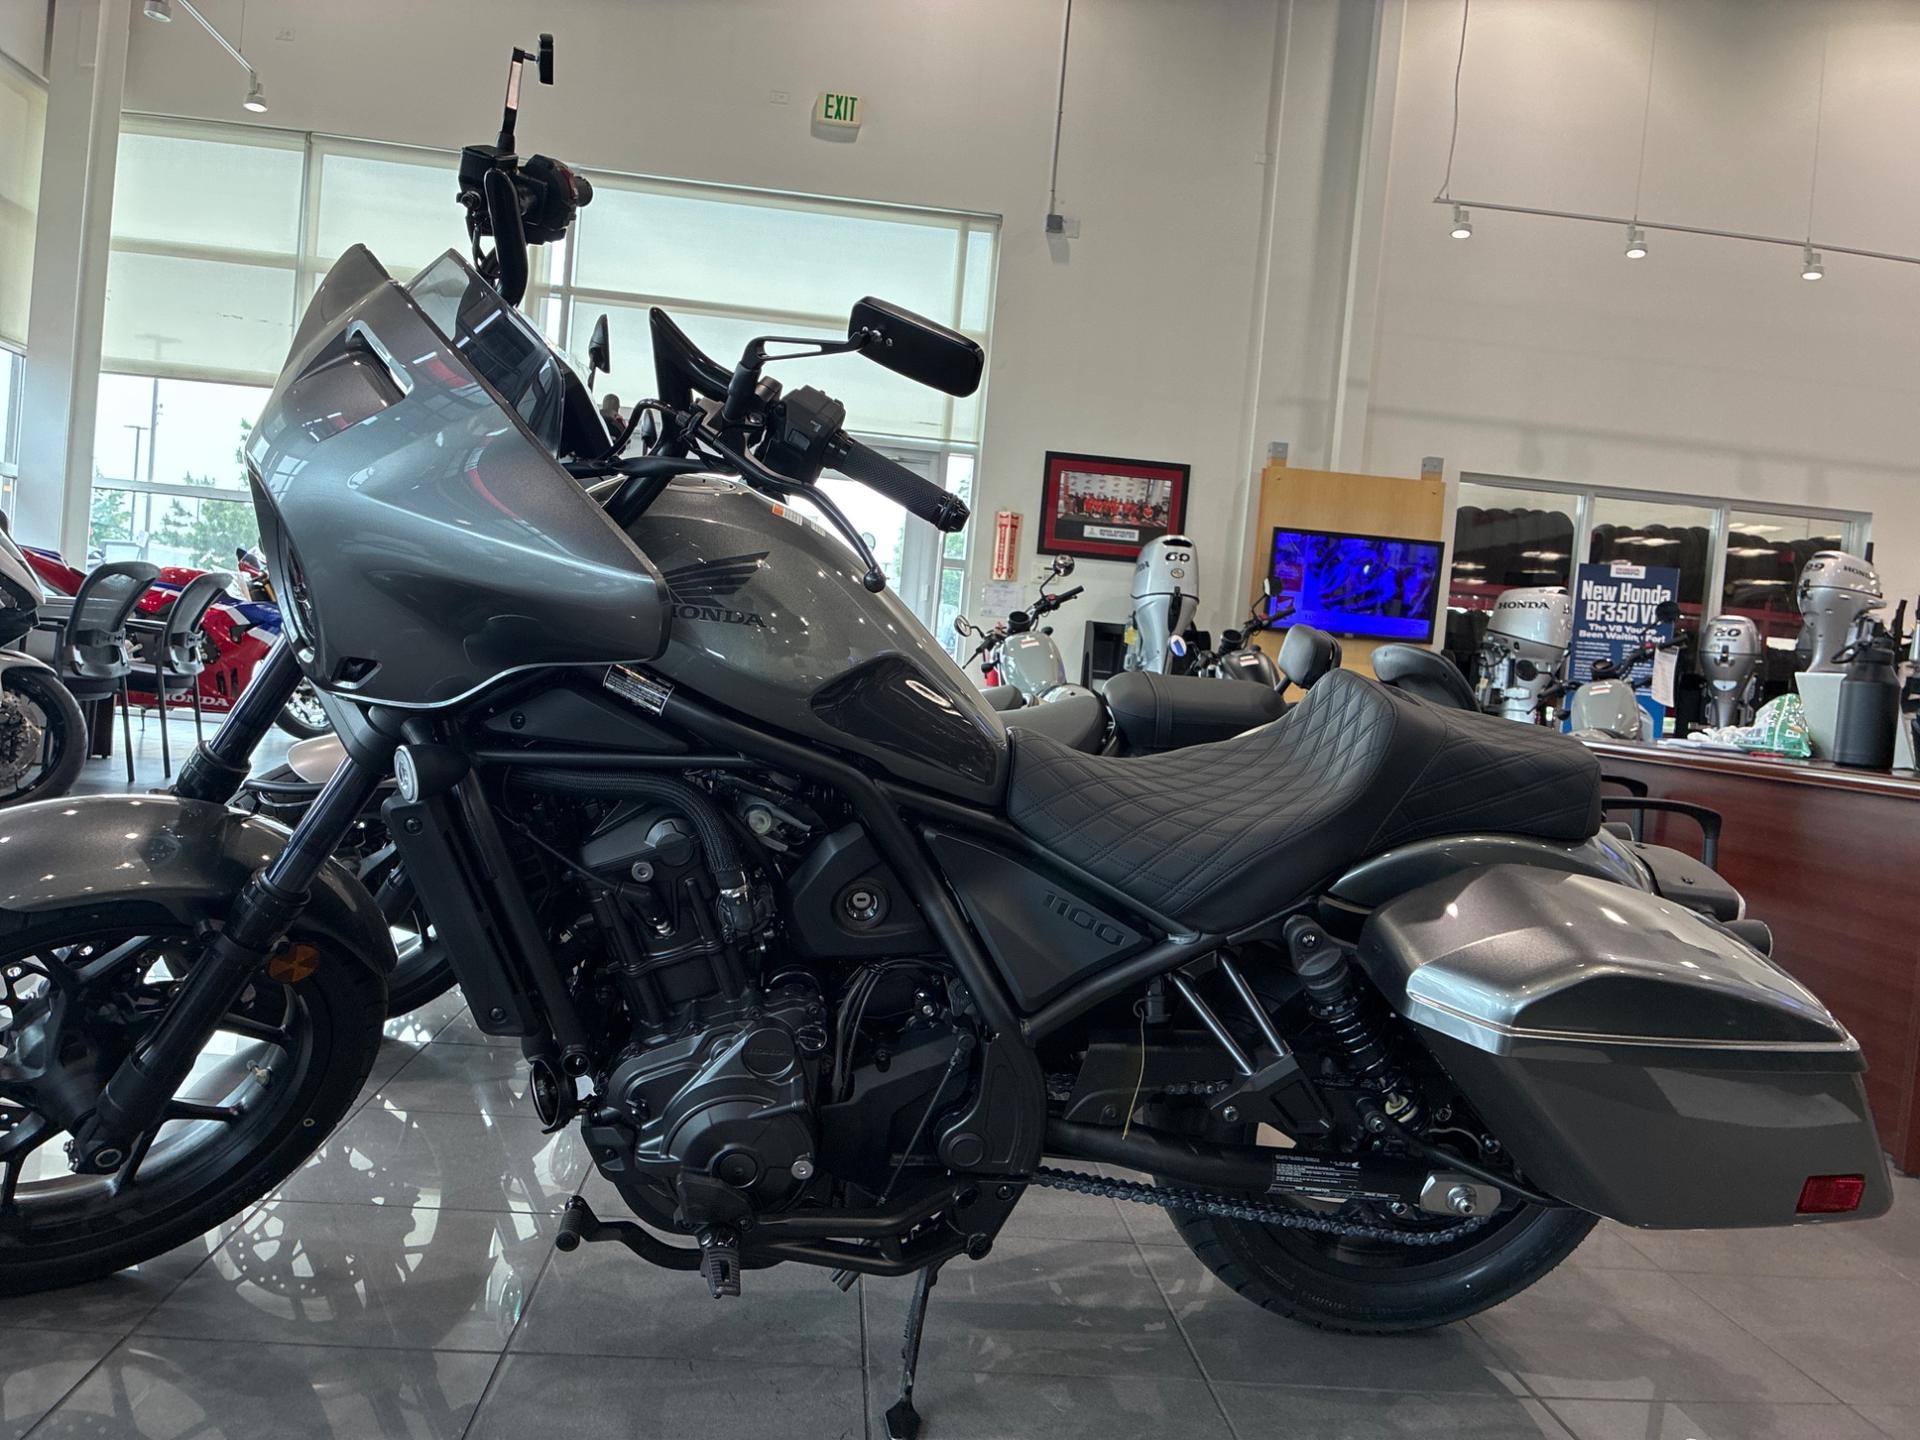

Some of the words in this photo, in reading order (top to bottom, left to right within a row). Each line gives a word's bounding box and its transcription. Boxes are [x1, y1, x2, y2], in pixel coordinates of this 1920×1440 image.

[824, 93, 858, 121] EXIT
[1165, 552, 1190, 562] 60
[1581, 580, 1617, 600] New
[1620, 582, 1671, 605] Honda
[1498, 601, 1550, 610] HONDA
[1586, 600, 1638, 624] BF350
[1579, 629, 1604, 639] Been
[1588, 623, 1607, 632] The
[1608, 624, 1623, 633] V8
[1624, 625, 1657, 635] You'e
[1044, 888, 1126, 947] 1100
